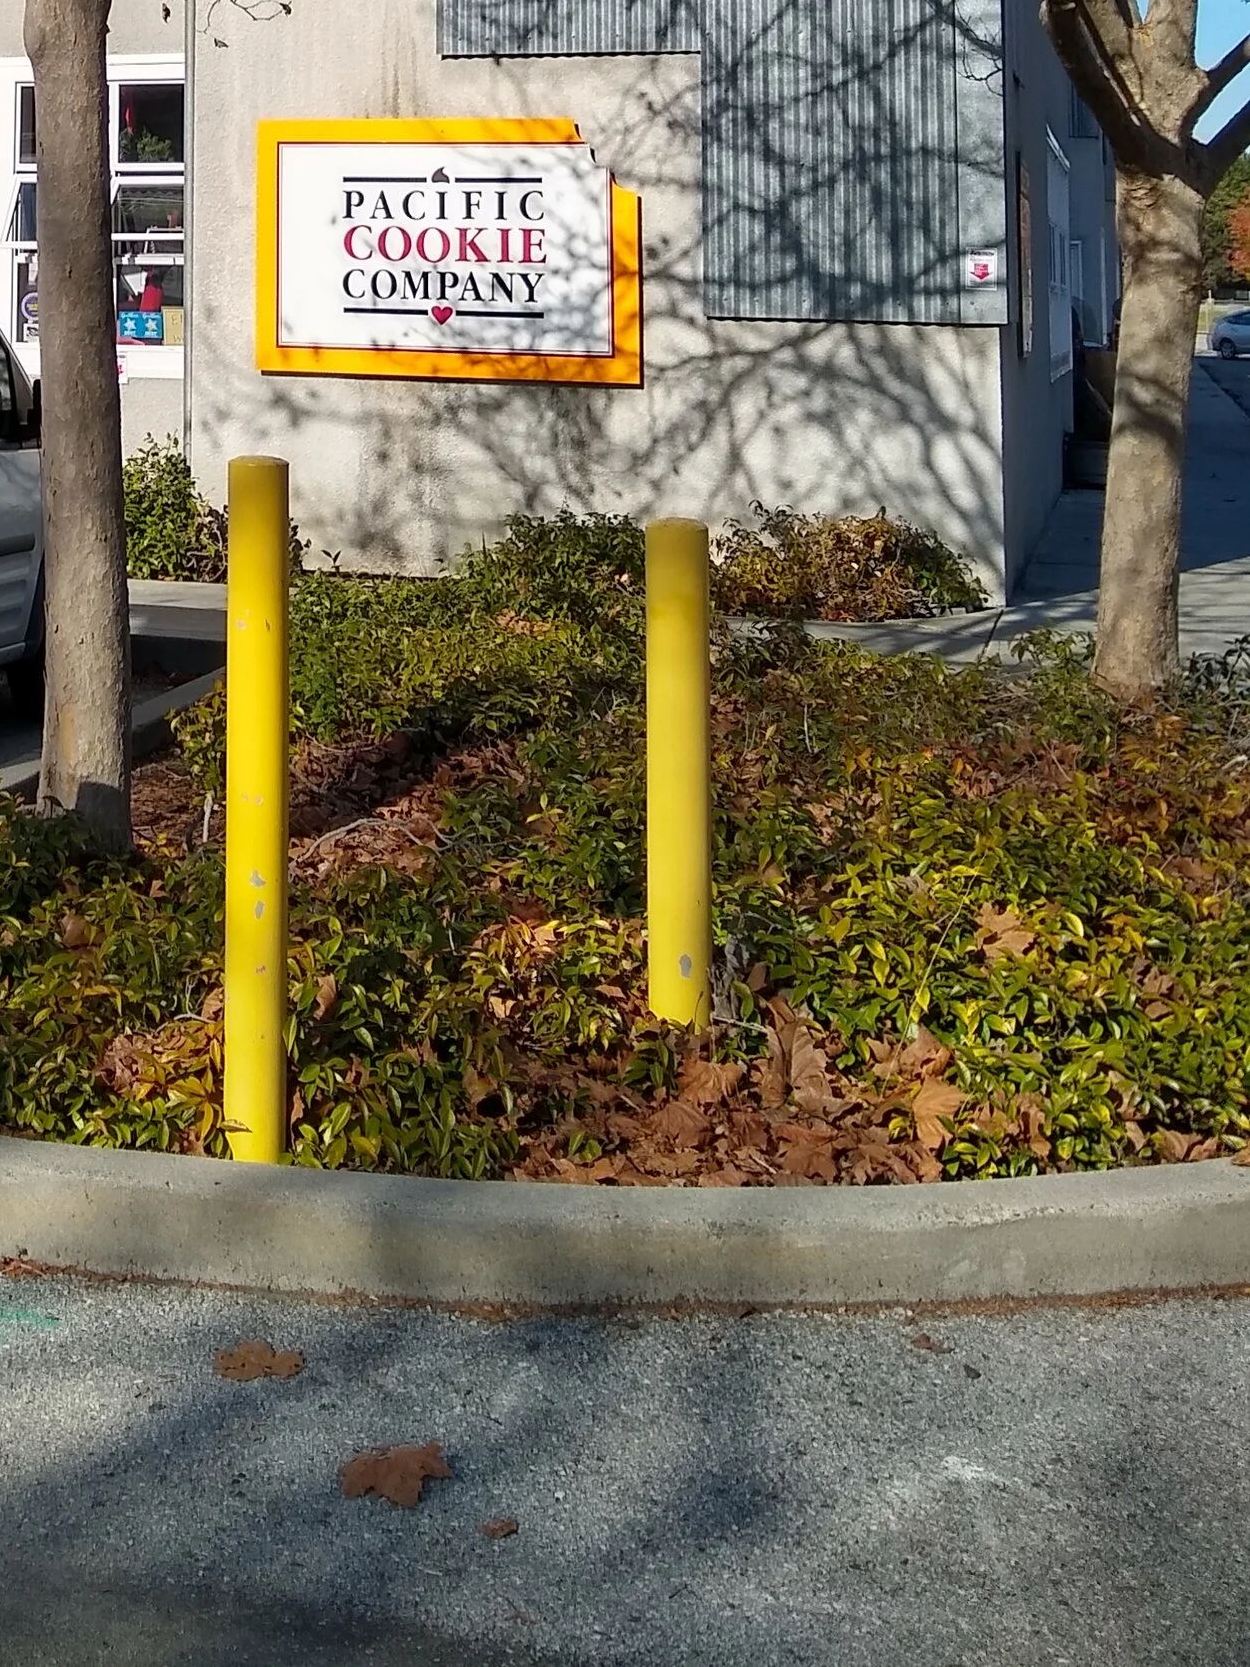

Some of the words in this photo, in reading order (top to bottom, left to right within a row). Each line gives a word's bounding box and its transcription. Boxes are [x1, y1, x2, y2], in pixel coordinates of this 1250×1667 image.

[342, 190, 545, 221] PACIFIC
[343, 224, 547, 264] COOKIE
[342, 269, 545, 303] COMPANY
